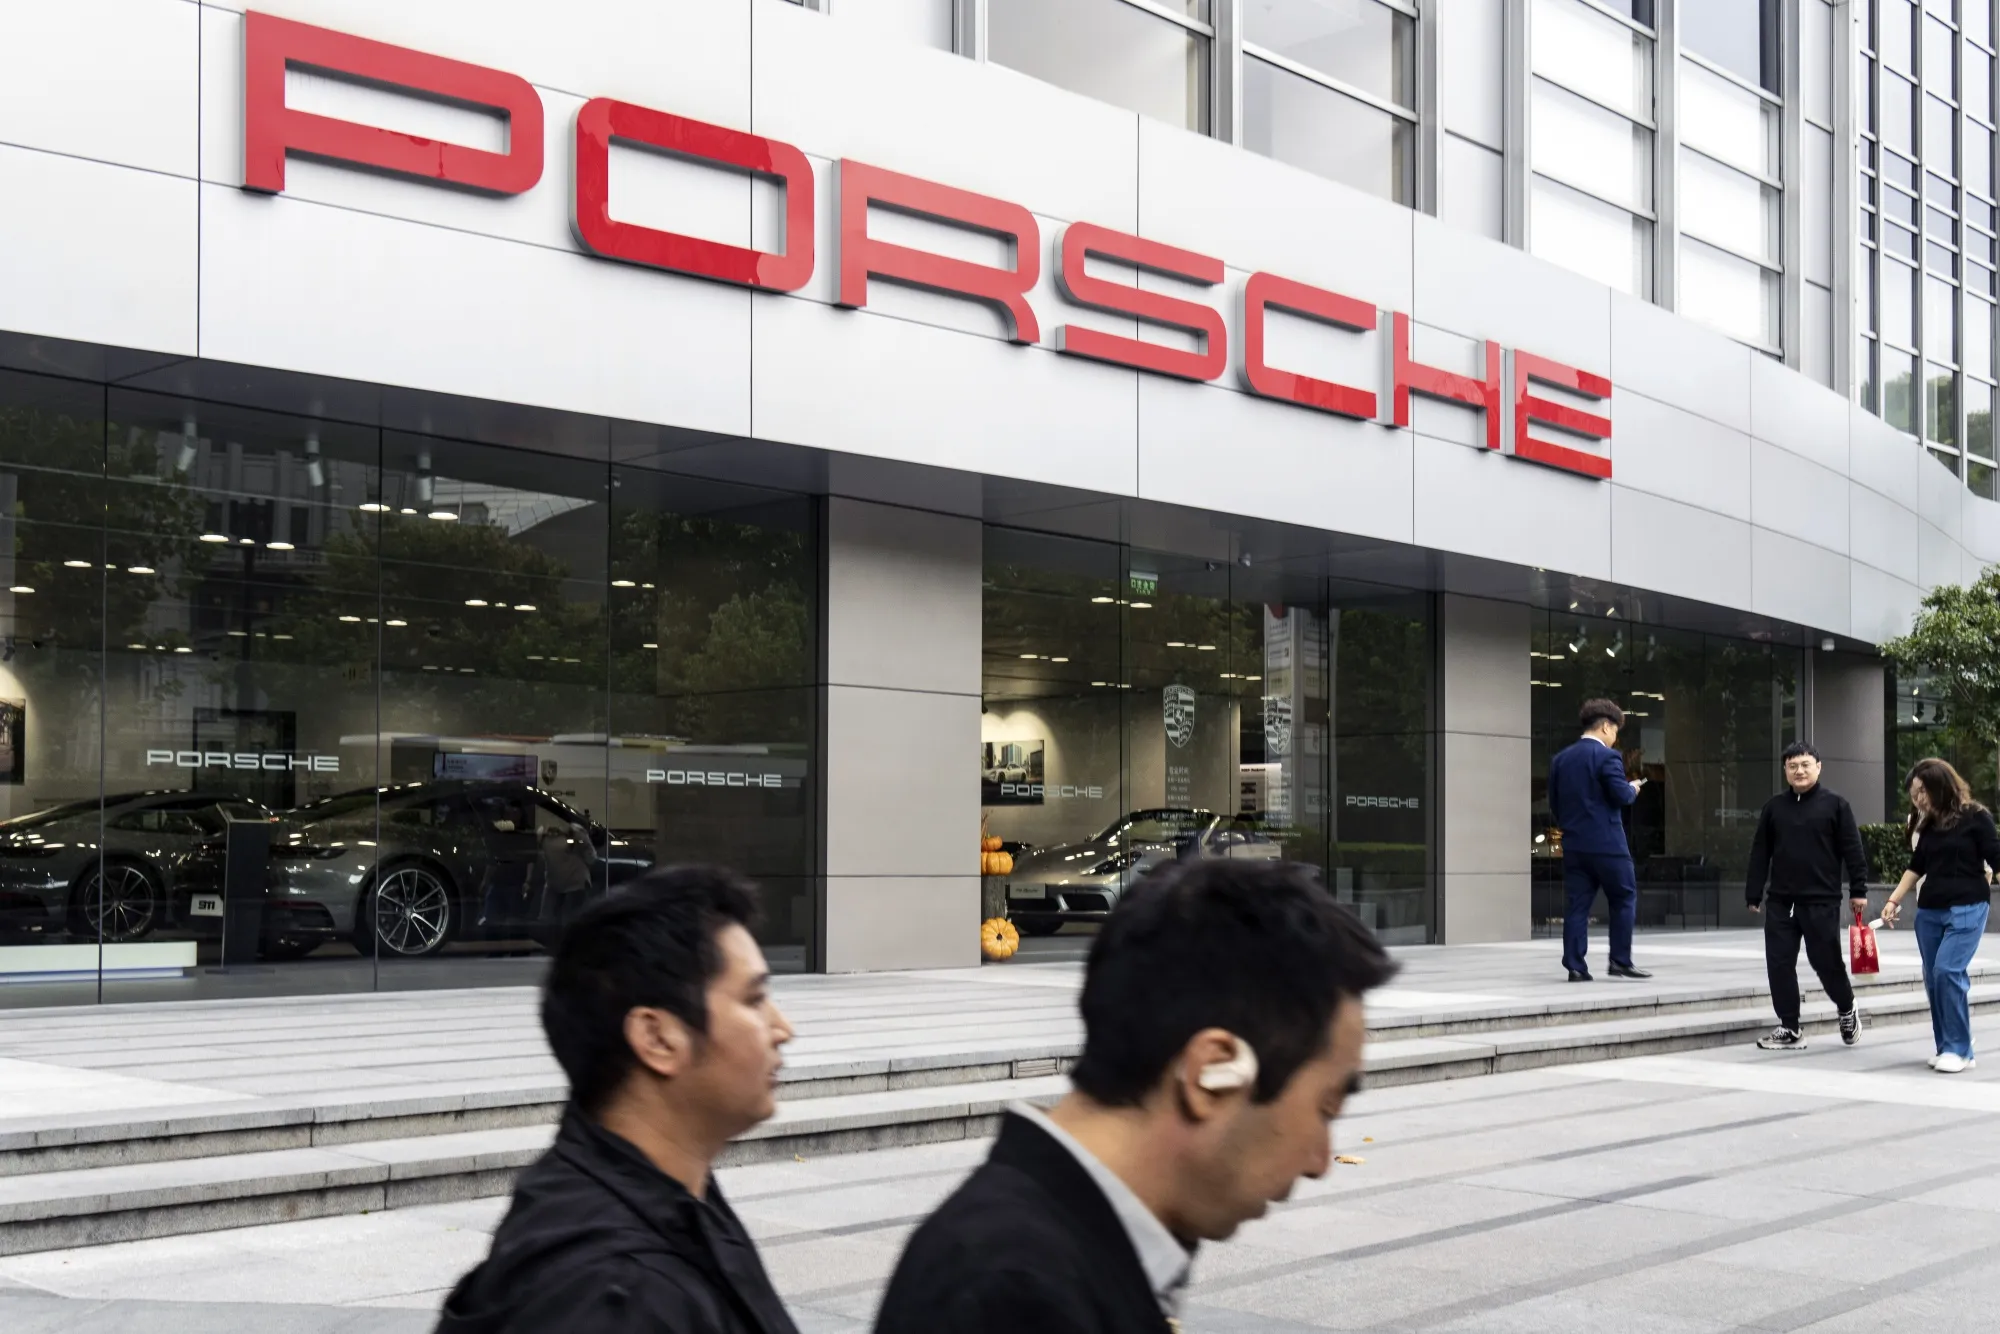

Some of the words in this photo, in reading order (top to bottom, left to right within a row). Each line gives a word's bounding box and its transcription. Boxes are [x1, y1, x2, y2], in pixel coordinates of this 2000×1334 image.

[241, 10, 1613, 480] PORSCHE
[146, 749, 339, 772] PORSCHE
[646, 769, 782, 788] PORSCHE
[1001, 783, 1103, 799] PORSCHE
[1345, 796, 1419, 809] PORSCHE
[198, 900, 216, 910] 911
